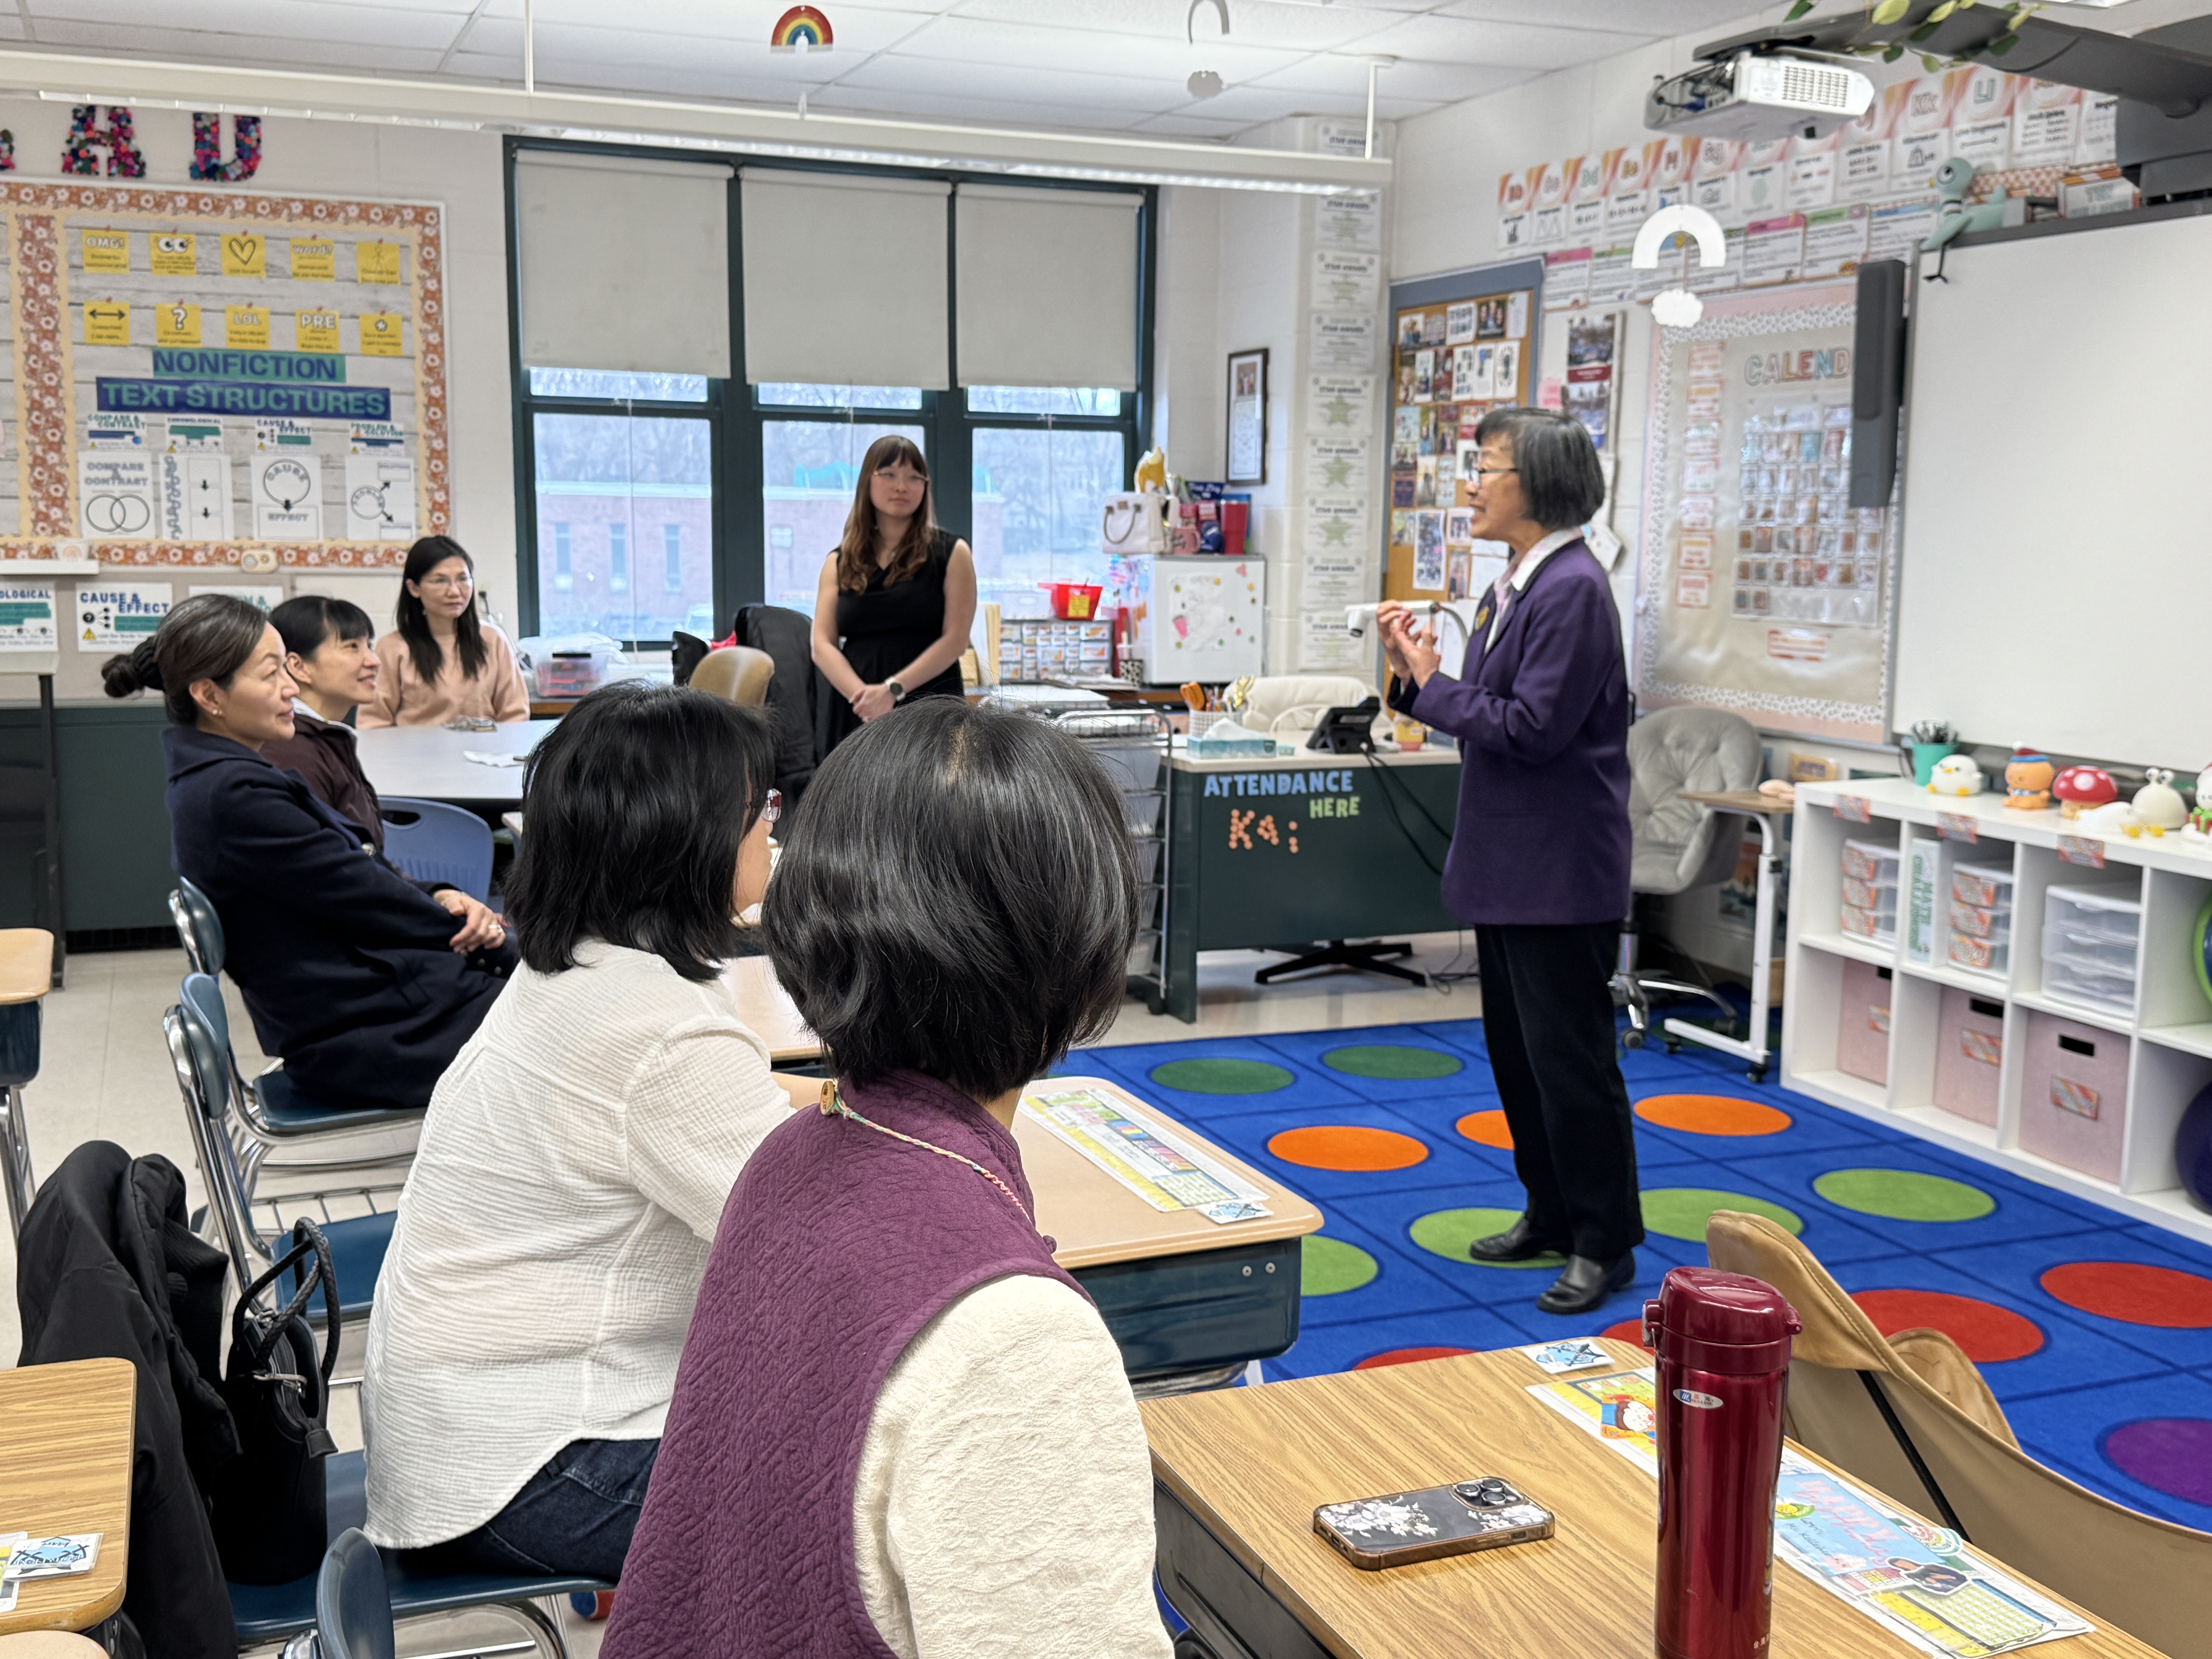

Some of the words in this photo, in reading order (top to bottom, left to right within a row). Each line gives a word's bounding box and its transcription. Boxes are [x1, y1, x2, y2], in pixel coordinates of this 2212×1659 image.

[86, 237, 124, 249] OMG!
[234, 312, 261, 325] LOL
[301, 314, 336, 329] PRE
[155, 350, 336, 379] NONFICTION
[1744, 348, 1851, 386] CALEND
[102, 383, 180, 407] TEXT
[186, 385, 386, 415] STRUCTURES
[87, 462, 145, 471] COMPARE
[266, 464, 310, 483] CAUSE
[85, 477, 148, 486] CONTRAST
[268, 513, 308, 522] EFFECT
[0, 589, 52, 599] OLOGICAL
[80, 592, 127, 603] CAUSE
[118, 603, 169, 613] EFFECT
[1204, 771, 1353, 798] ATTENDANCE
[1309, 796, 1360, 819] HERE
[1796, 1480, 1902, 1541] HAPPY
